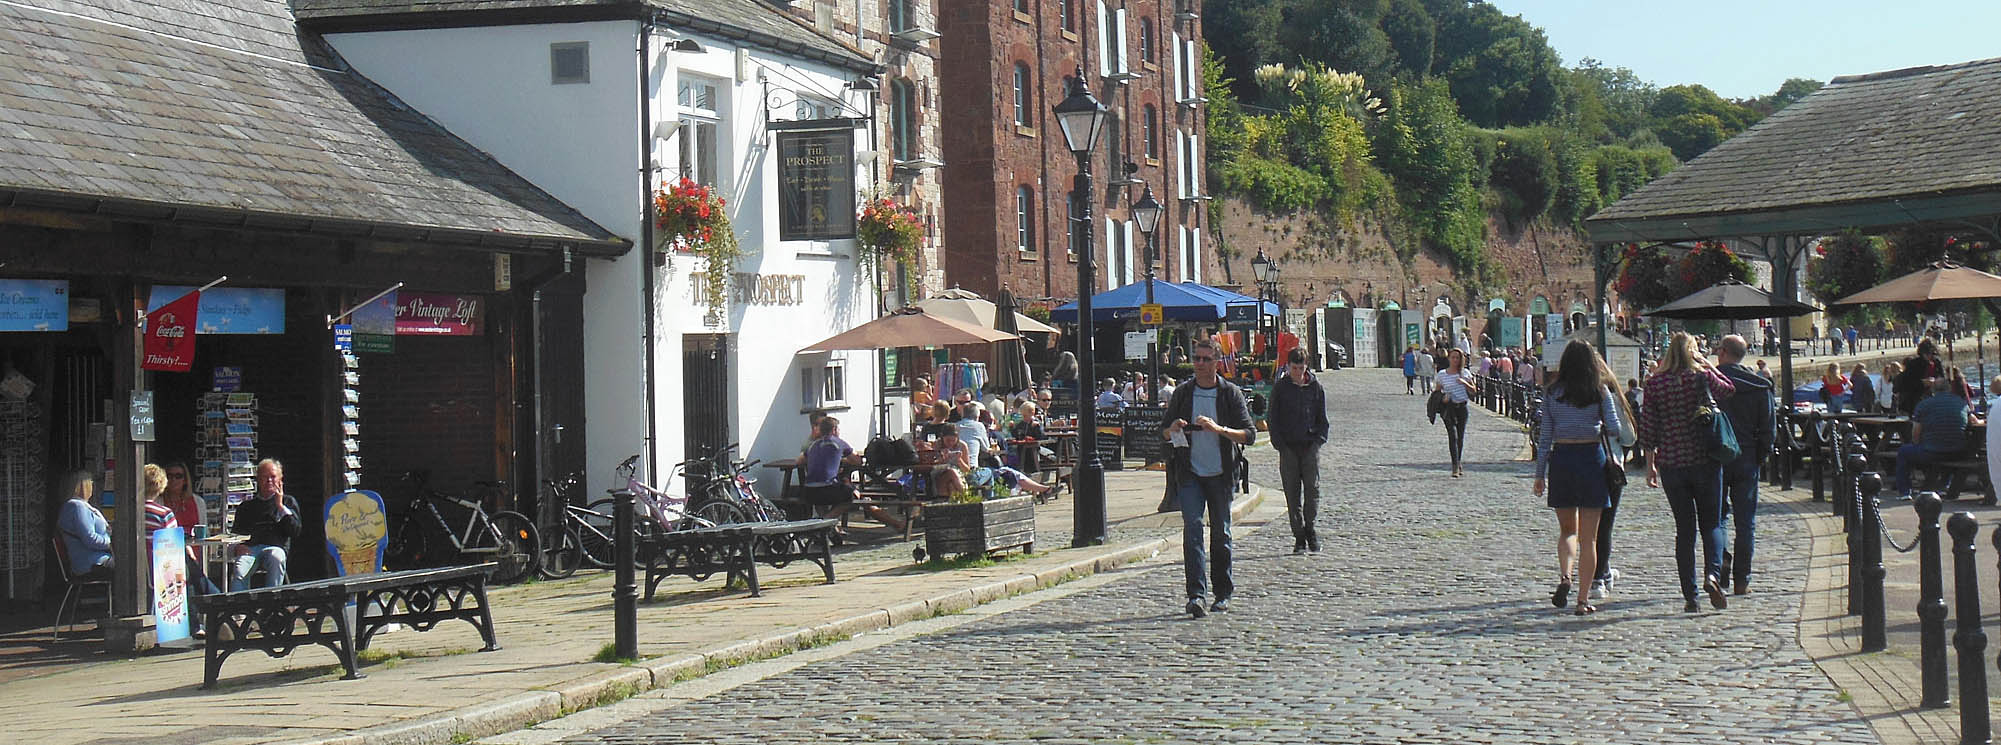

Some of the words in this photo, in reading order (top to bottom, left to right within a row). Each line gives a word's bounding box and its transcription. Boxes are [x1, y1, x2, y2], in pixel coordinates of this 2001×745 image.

[808, 147, 824, 155] THE
[786, 155, 846, 166] PROSPECT
[731, 272, 806, 306] PROSPECT
[410, 299, 451, 325] Vintage
[453, 298, 477, 325] Loft
[156, 325, 185, 337] Coca-Cola
[335, 328, 351, 336] SALMO
